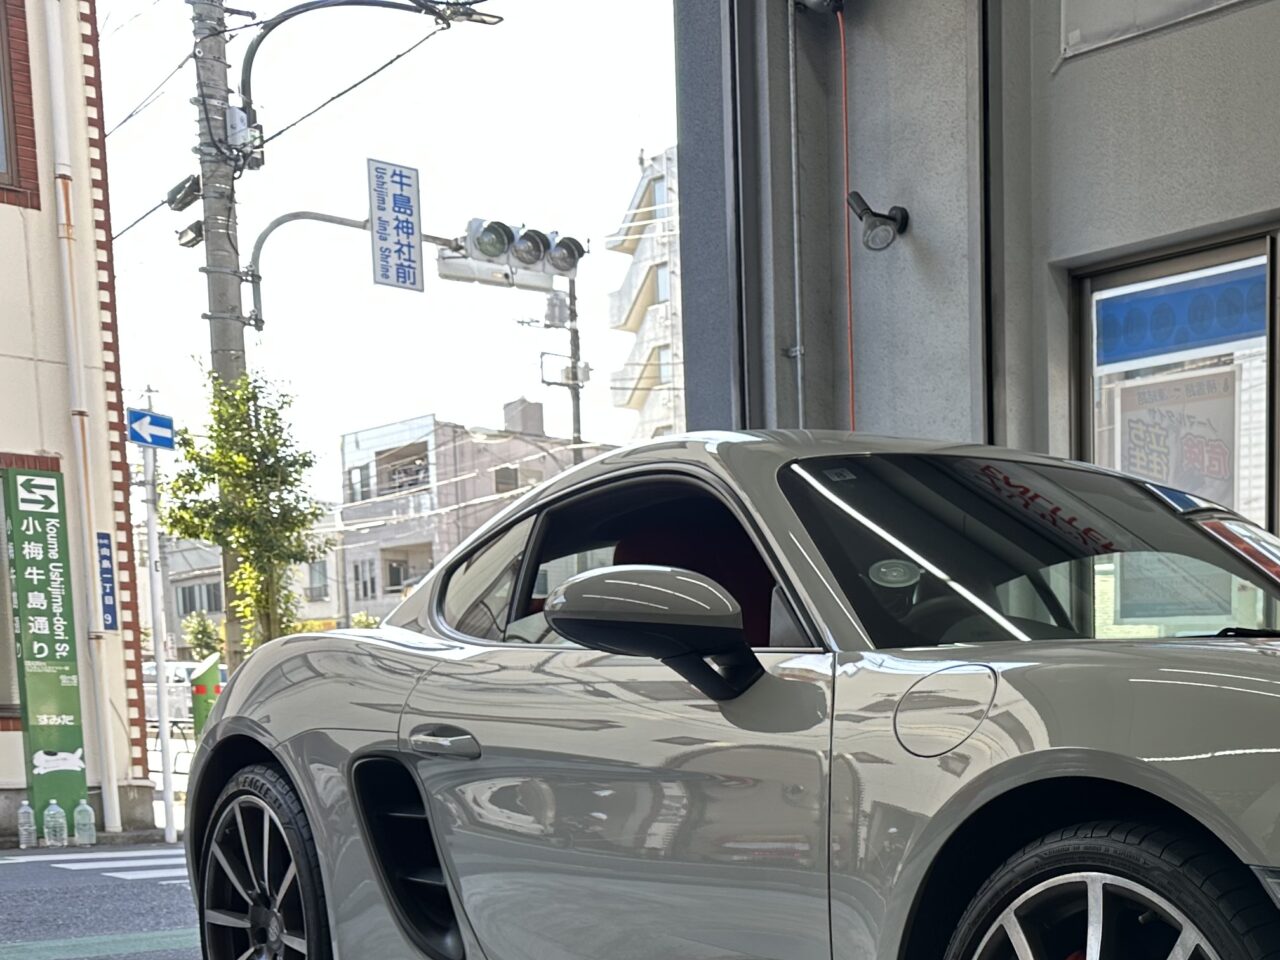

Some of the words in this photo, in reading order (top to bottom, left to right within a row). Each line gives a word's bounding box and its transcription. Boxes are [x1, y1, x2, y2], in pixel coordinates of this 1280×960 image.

[373, 166, 389, 212] Ushijima
[377, 216, 392, 242] Jinja
[390, 168, 417, 286] 牛島神社前
[379, 246, 393, 280] Shrine
[45, 517, 60, 560] Koume
[20, 516, 50, 659] 小梅牛島通り
[49, 562, 69, 640] Ushijima-dori
[104, 613, 112, 625] 9
[55, 642, 70, 659] St.
[36, 714, 75, 726] すみだ
[241, 776, 271, 799] EAGLE
